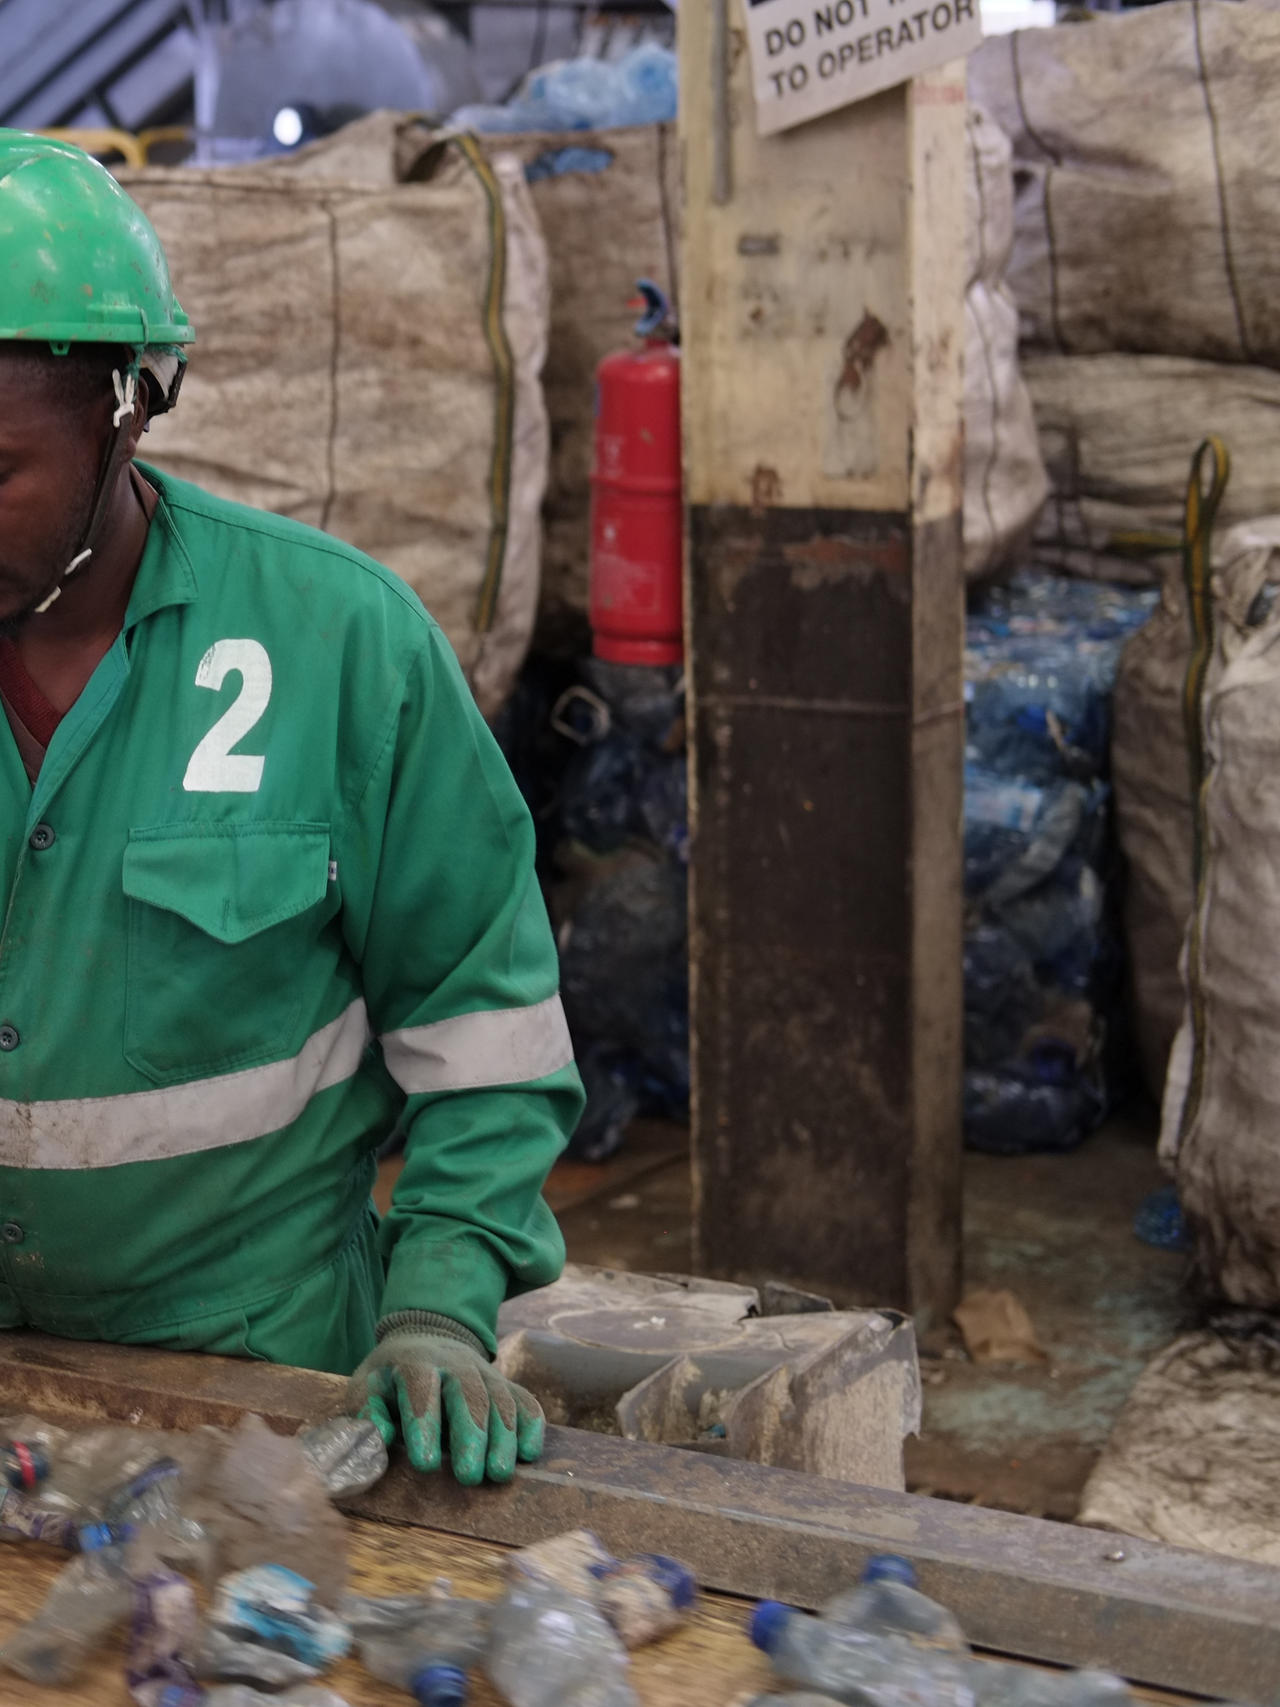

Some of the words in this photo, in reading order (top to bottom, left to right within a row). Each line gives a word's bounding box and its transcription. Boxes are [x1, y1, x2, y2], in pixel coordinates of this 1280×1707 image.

[765, 19, 806, 56] DO
[770, 63, 808, 99] TO
[817, 0, 973, 79] OPERATOR
[182, 638, 273, 793] 2
